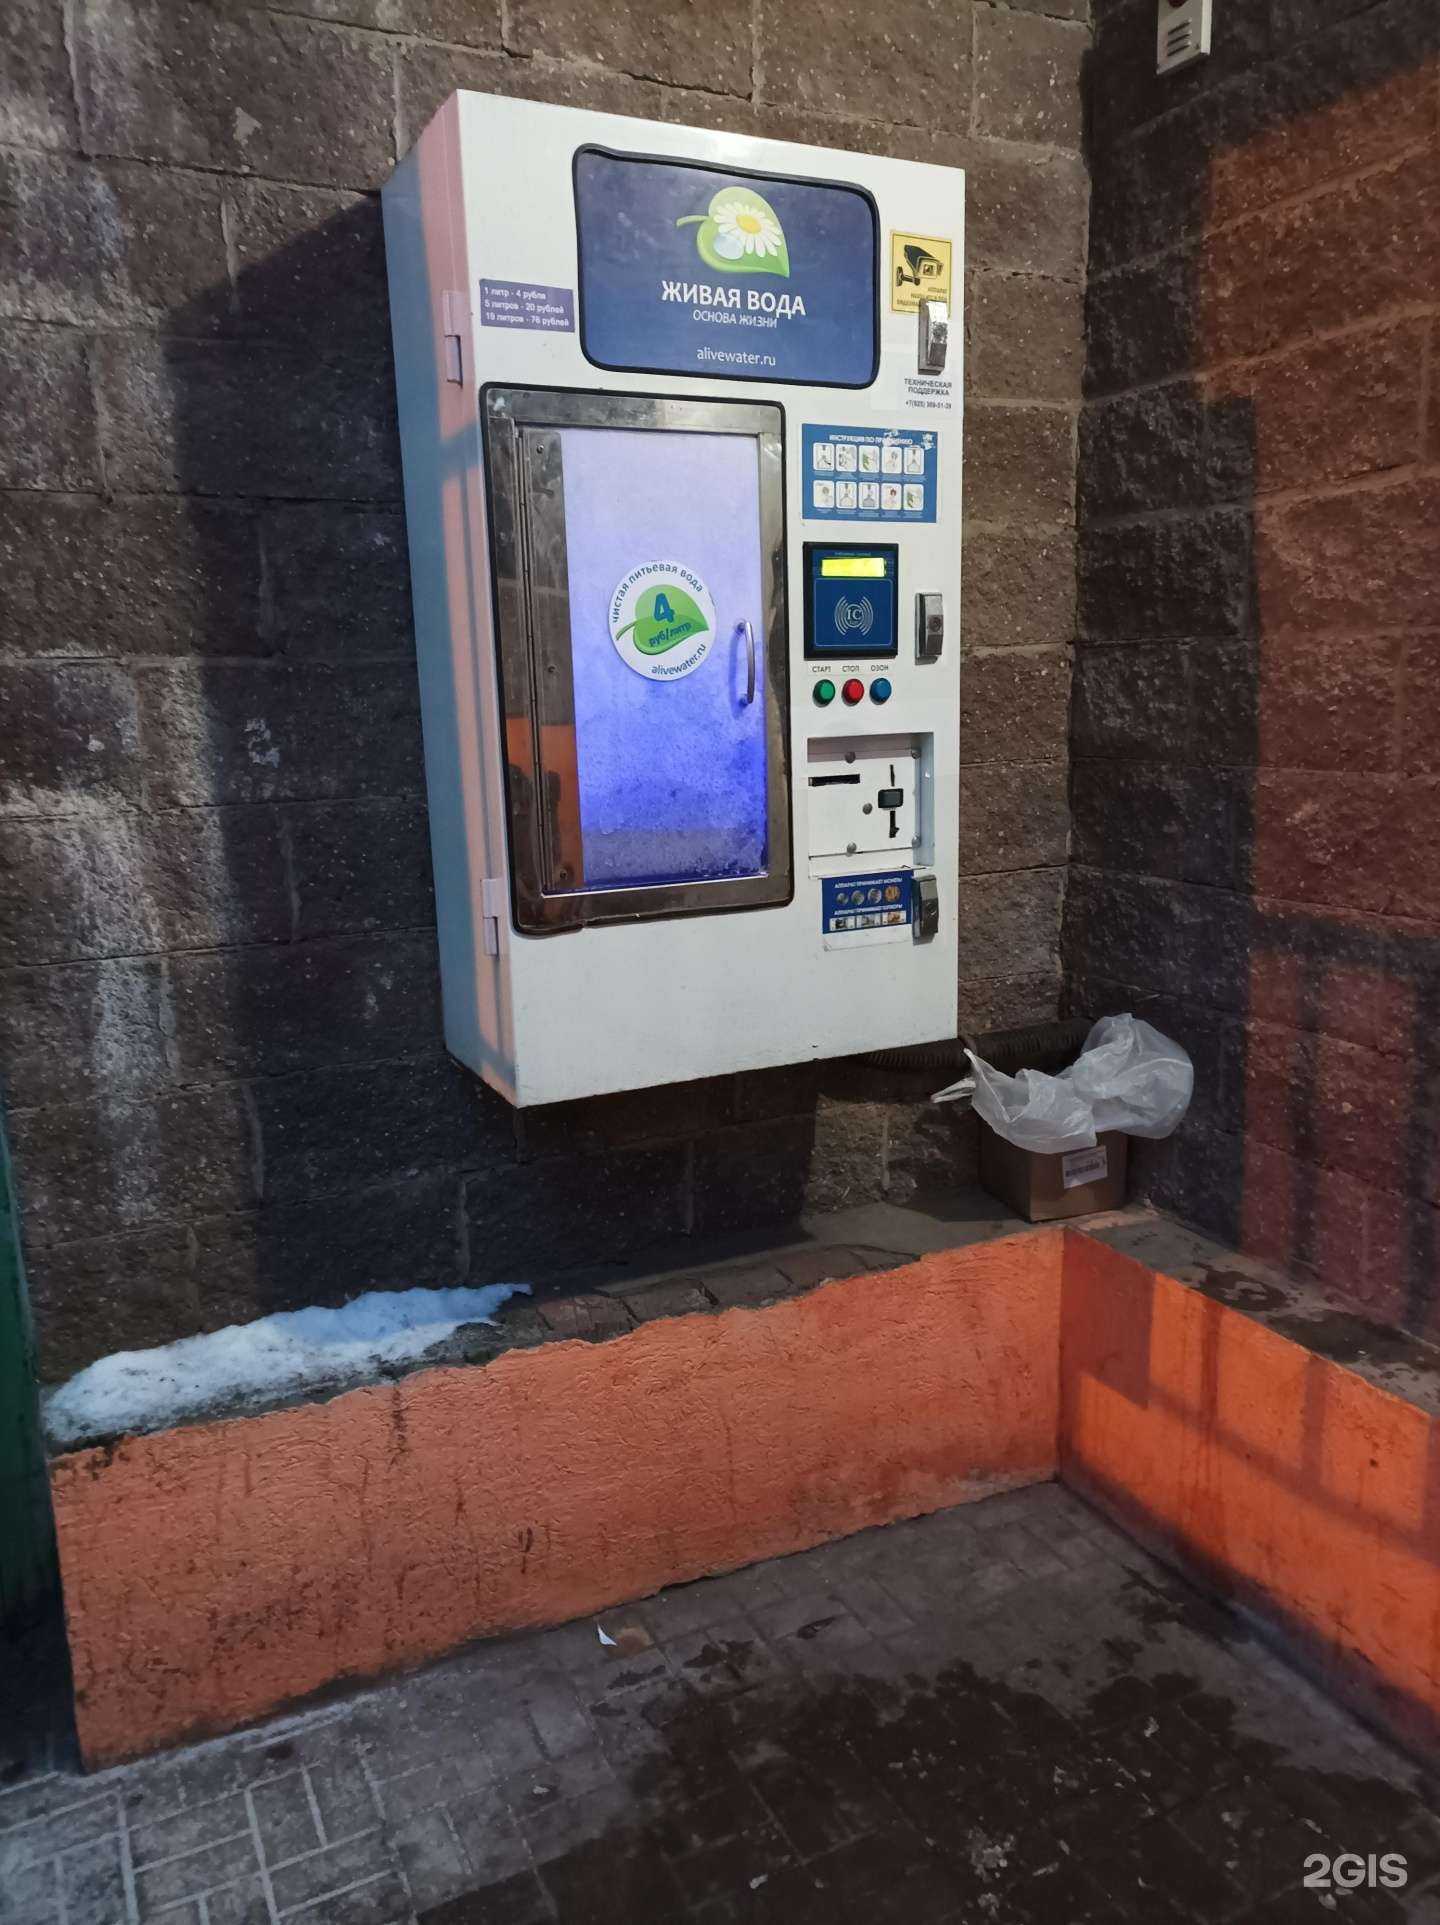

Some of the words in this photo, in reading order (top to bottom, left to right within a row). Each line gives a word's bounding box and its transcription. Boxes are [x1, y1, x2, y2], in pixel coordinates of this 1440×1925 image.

[484, 287, 489, 295] 1
[491, 288, 510, 298] литр
[516, 289, 521, 297] 4
[662, 280, 741, 309] ЖИВАЯ
[747, 293, 806, 319] ВОДА
[484, 299, 490, 308] 5
[491, 301, 519, 311] литров
[496, 313, 524, 323] литров
[693, 309, 737, 325] ОСНОВА
[738, 313, 778, 329] ЖИЗНИ
[697, 347, 776, 367] alivewater.ru
[904, 378, 952, 388] ТЕХНИЧЕСКАЯ
[908, 386, 949, 395] ПОДДЕРЖКА
[612, 583, 630, 623] чистая
[629, 563, 678, 584] питьевая
[680, 569, 703, 592] вода
[653, 592, 675, 623] 4
[649, 622, 692, 647] руб/литр
[651, 643, 706, 676] alivewater.ru
[812, 665, 831, 673] СТАРТ
